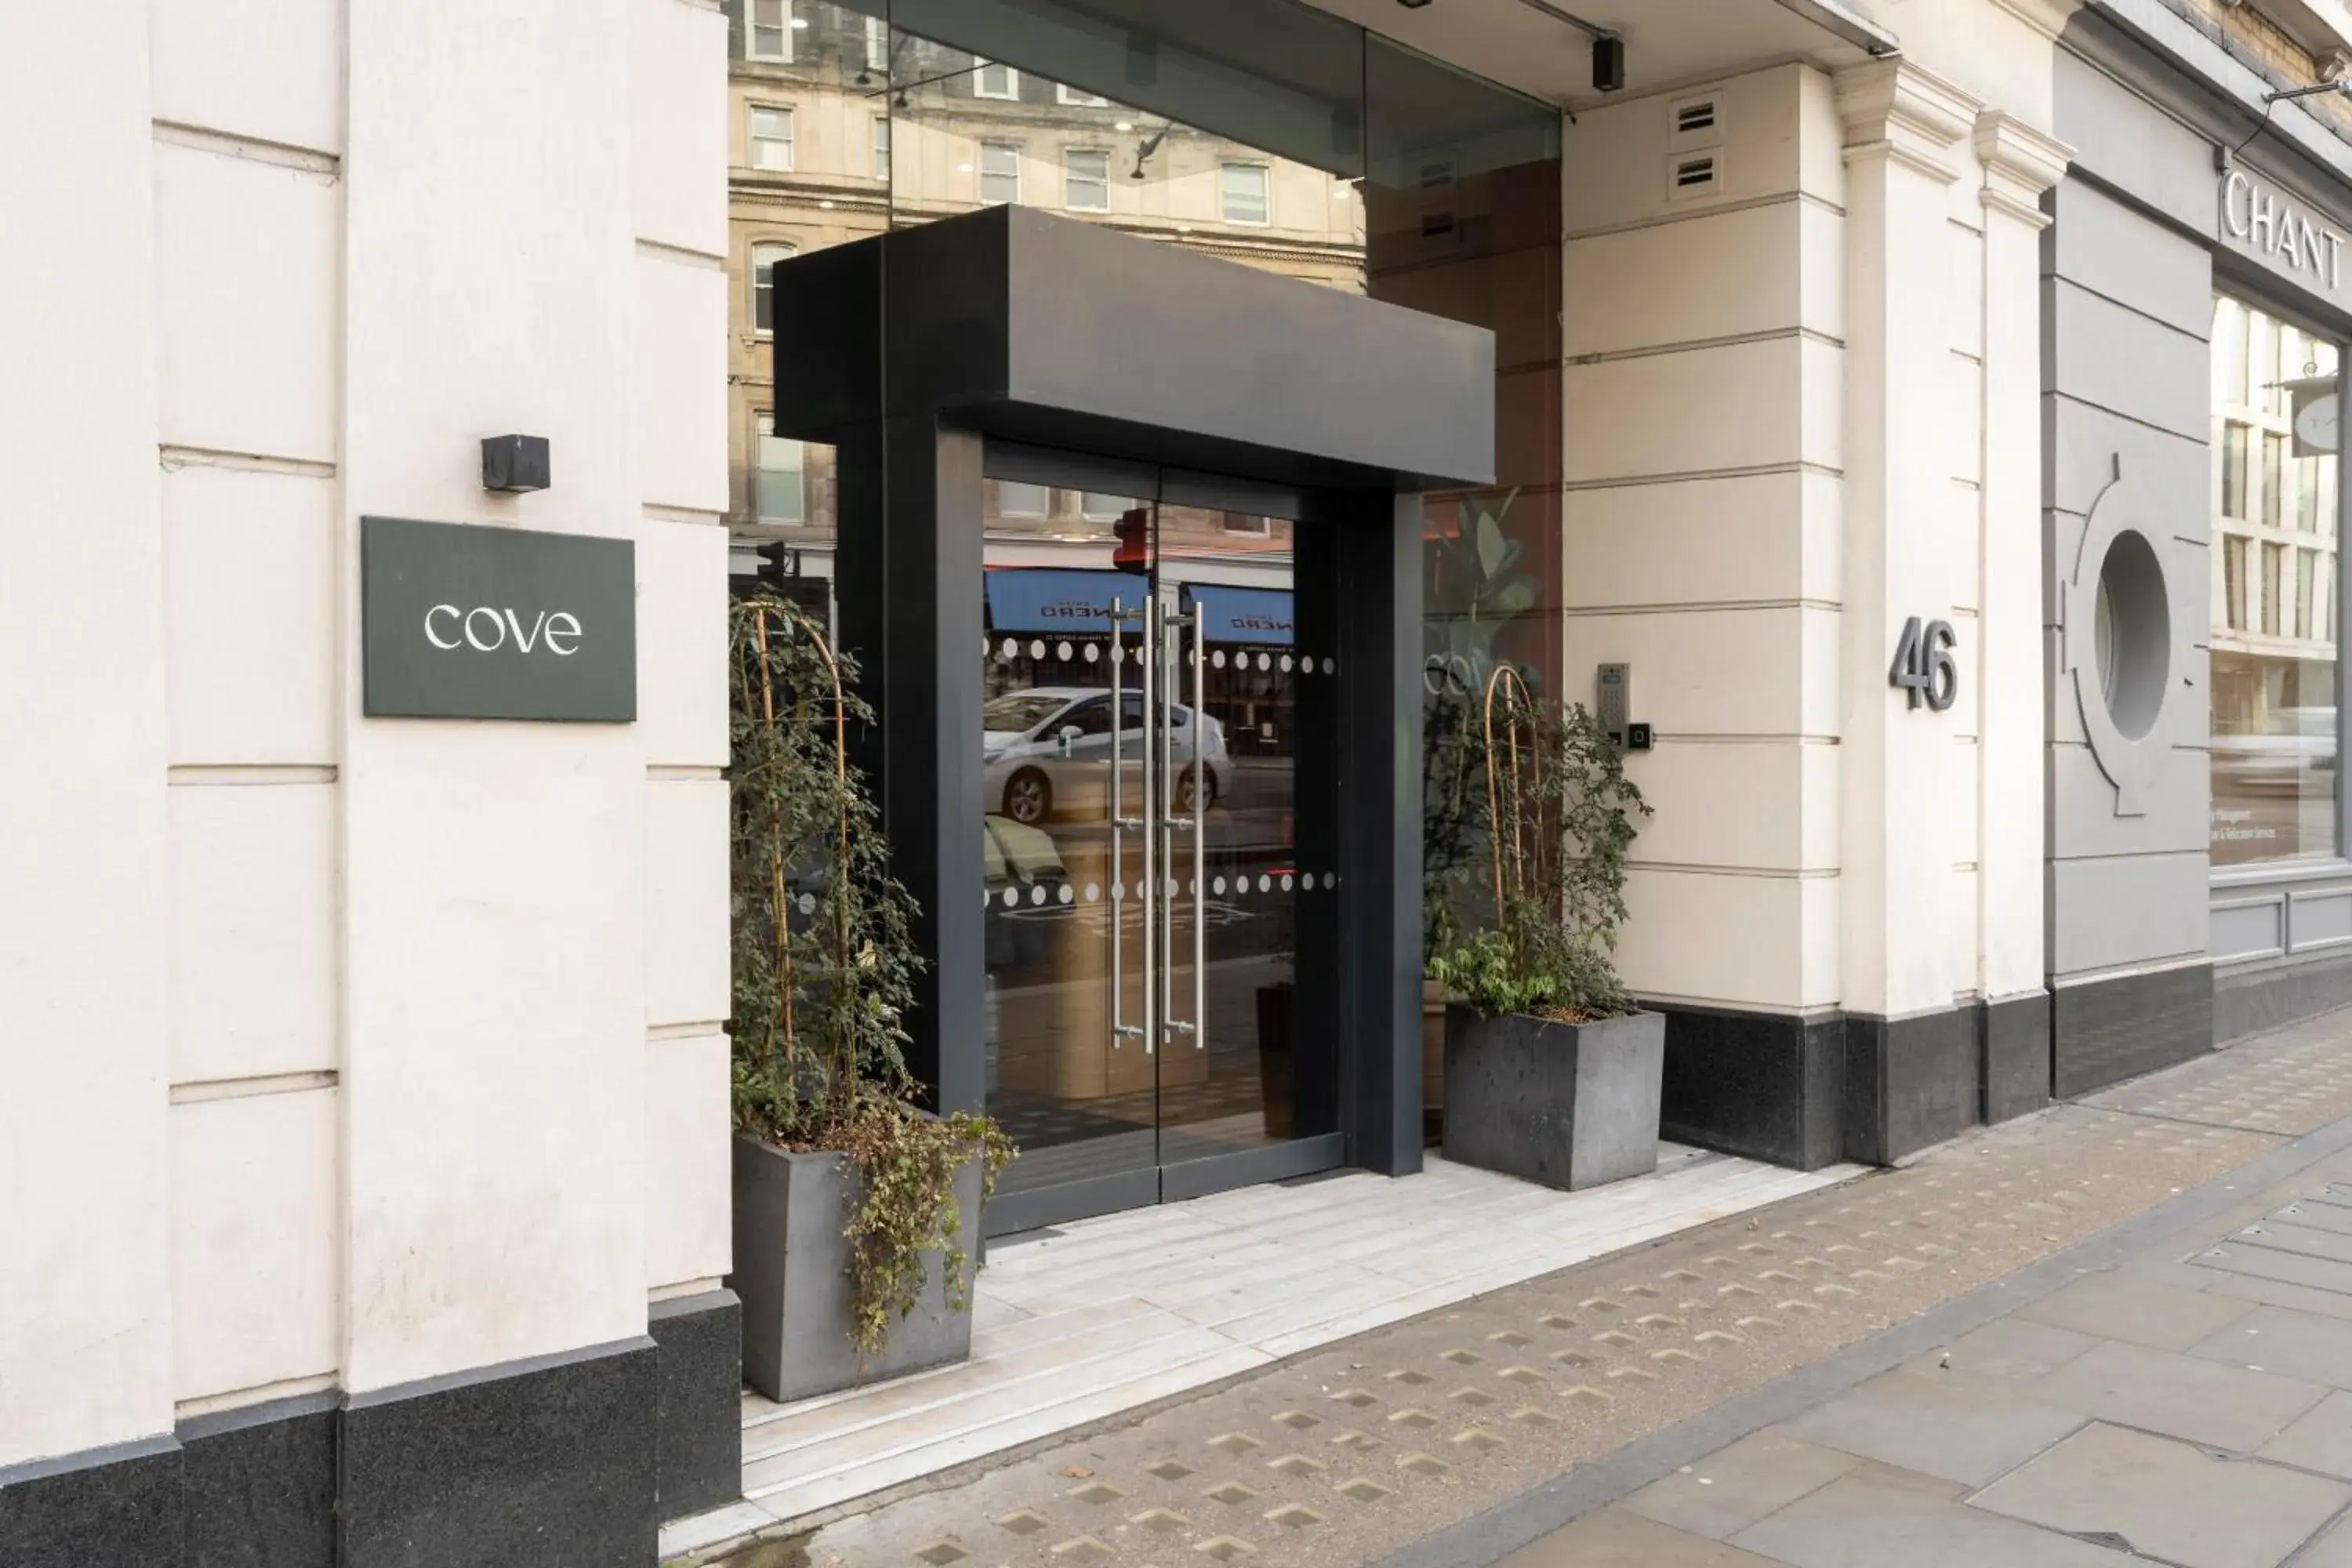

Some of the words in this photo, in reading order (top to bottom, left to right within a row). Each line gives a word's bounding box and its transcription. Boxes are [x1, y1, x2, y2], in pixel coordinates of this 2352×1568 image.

[2225, 172, 2346, 289] CHANT
[424, 604, 583, 655] cove
[1889, 616, 1958, 712] 46
